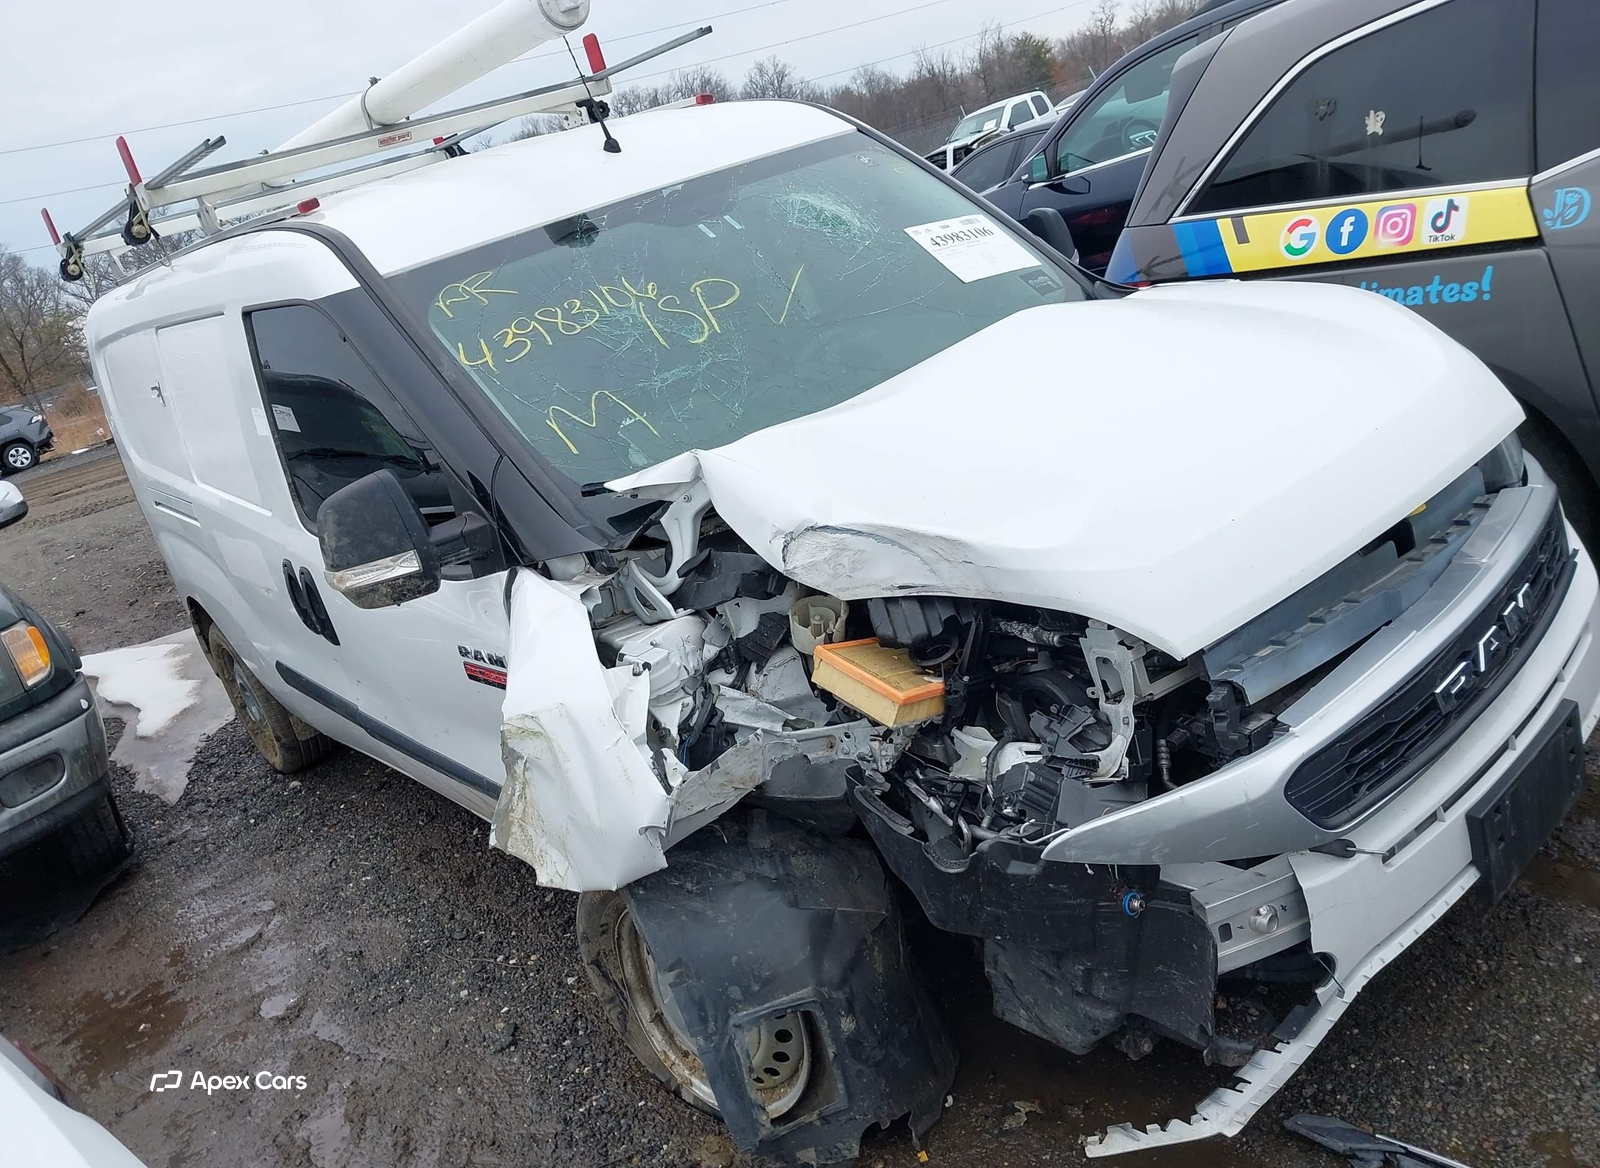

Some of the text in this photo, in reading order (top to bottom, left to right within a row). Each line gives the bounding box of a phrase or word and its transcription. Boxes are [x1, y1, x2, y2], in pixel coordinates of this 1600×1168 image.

[930, 226, 994, 247] 43983106
[1428, 233, 1457, 243] TikTok
[546, 390, 659, 455] M
[457, 644, 508, 669] RAM
